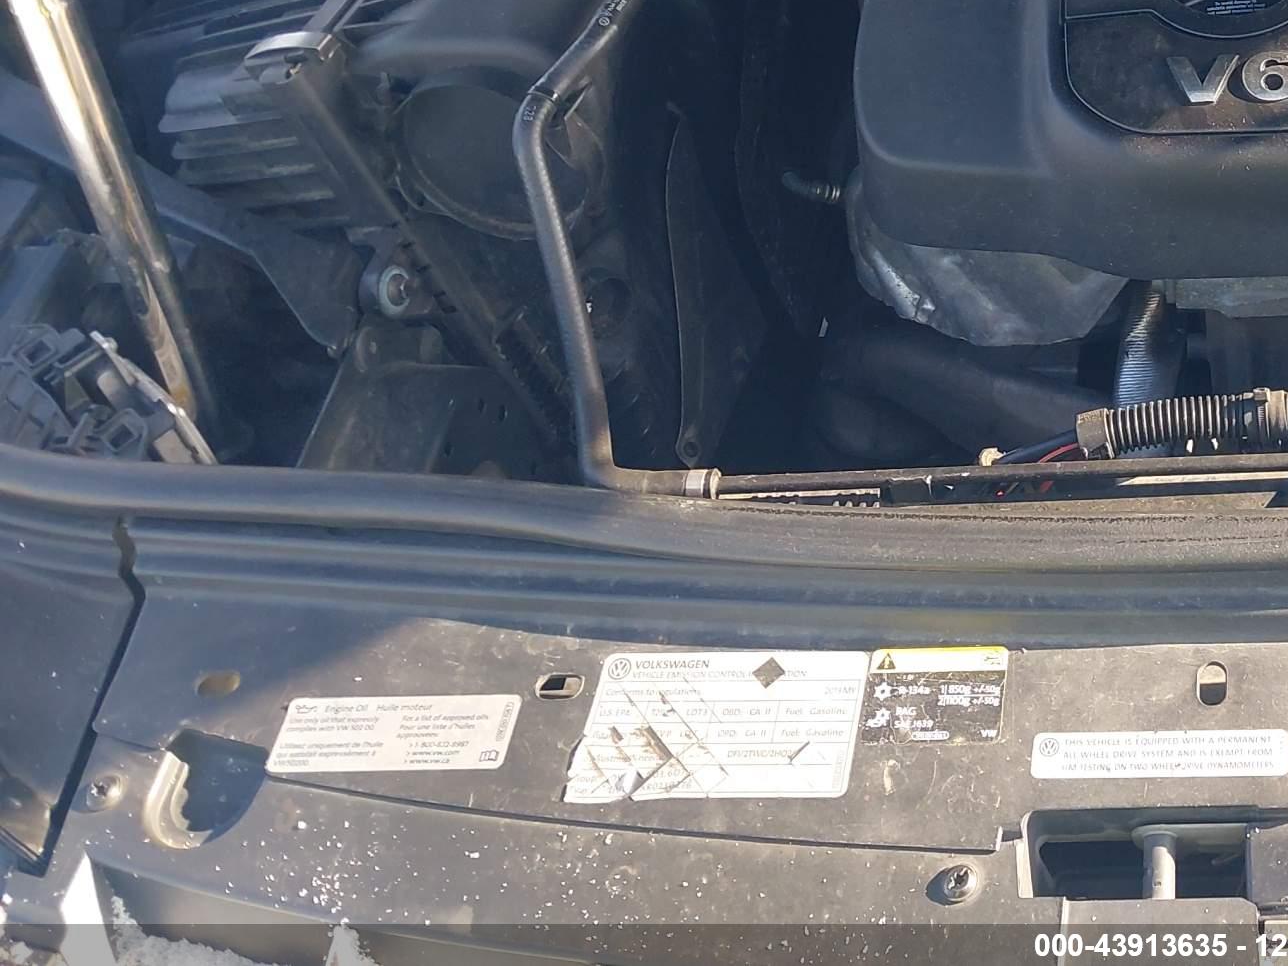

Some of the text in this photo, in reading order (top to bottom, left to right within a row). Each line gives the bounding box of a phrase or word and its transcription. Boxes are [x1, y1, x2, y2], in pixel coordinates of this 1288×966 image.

[635, 659, 710, 669] VOLKSWAGEN
[632, 671, 665, 679] VEHICLE
[708, 670, 746, 678] CONTROL
[646, 688, 655, 696] to
[897, 685, 931, 695] R-134a
[948, 685, 972, 695] 850g
[324, 703, 433, 715] Engine Oil Huile moteur
[809, 706, 848, 715] Gasoline
[805, 727, 845, 737] Gasoline
[980, 729, 998, 738] VW
[1064, 738, 1083, 746] THIS
[1086, 738, 1122, 746] VEHICLE
[1135, 737, 1179, 746] EQUIPPED
[1182, 737, 1206, 745] WITH
[1218, 735, 1272, 744] PERMANENT
[1113, 750, 1138, 759] DRIVE
[1141, 749, 1174, 758] SYSTEM
[1177, 749, 1196, 758] AND
[1209, 748, 1245, 758] EXEMPT
[1247, 748, 1273, 756] FROM
[1114, 763, 1128, 771] ON
[1130, 762, 1148, 771] TWO
